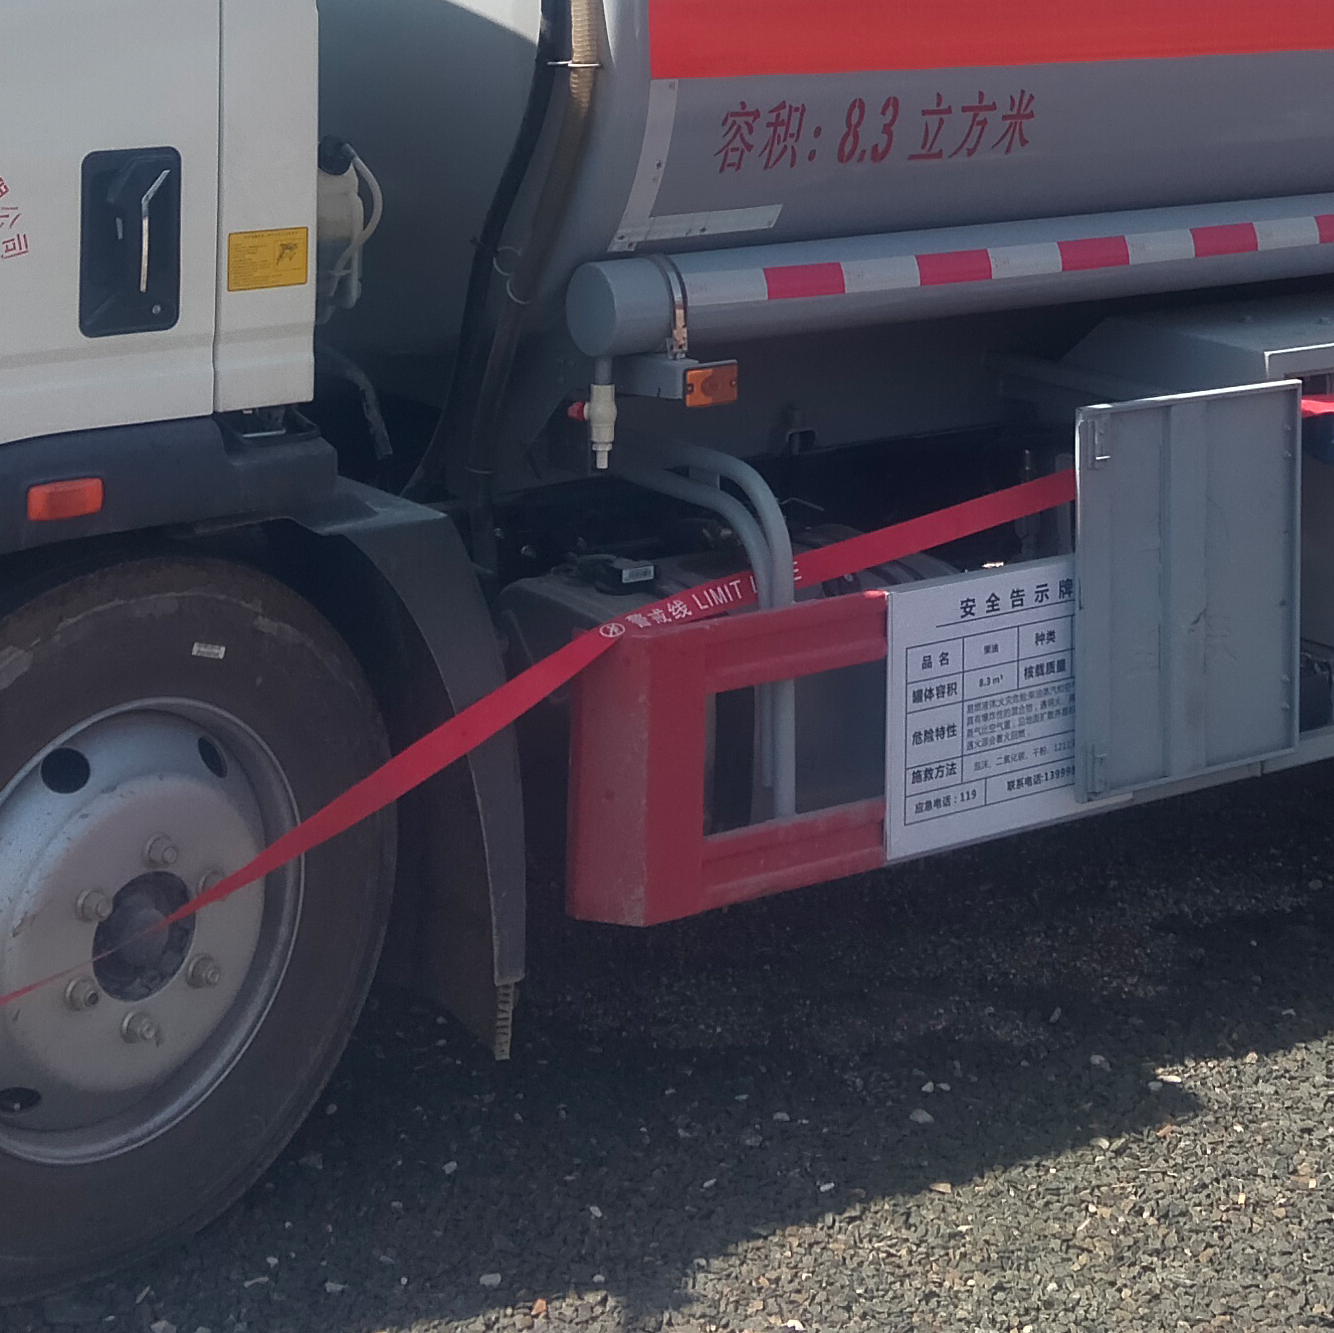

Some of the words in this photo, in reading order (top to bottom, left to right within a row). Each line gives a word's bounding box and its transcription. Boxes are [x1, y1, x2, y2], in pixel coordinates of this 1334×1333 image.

[625, 599, 693, 630] 警戒线
[691, 580, 743, 611] LIMIT
[960, 578, 1073, 619] 安全告示牌
[1034, 629, 1056, 647] 种类
[921, 651, 950, 670] 品名
[912, 682, 958, 704] 罐体容积
[912, 723, 957, 747] 危险特性
[911, 762, 957, 785] 施救方法
